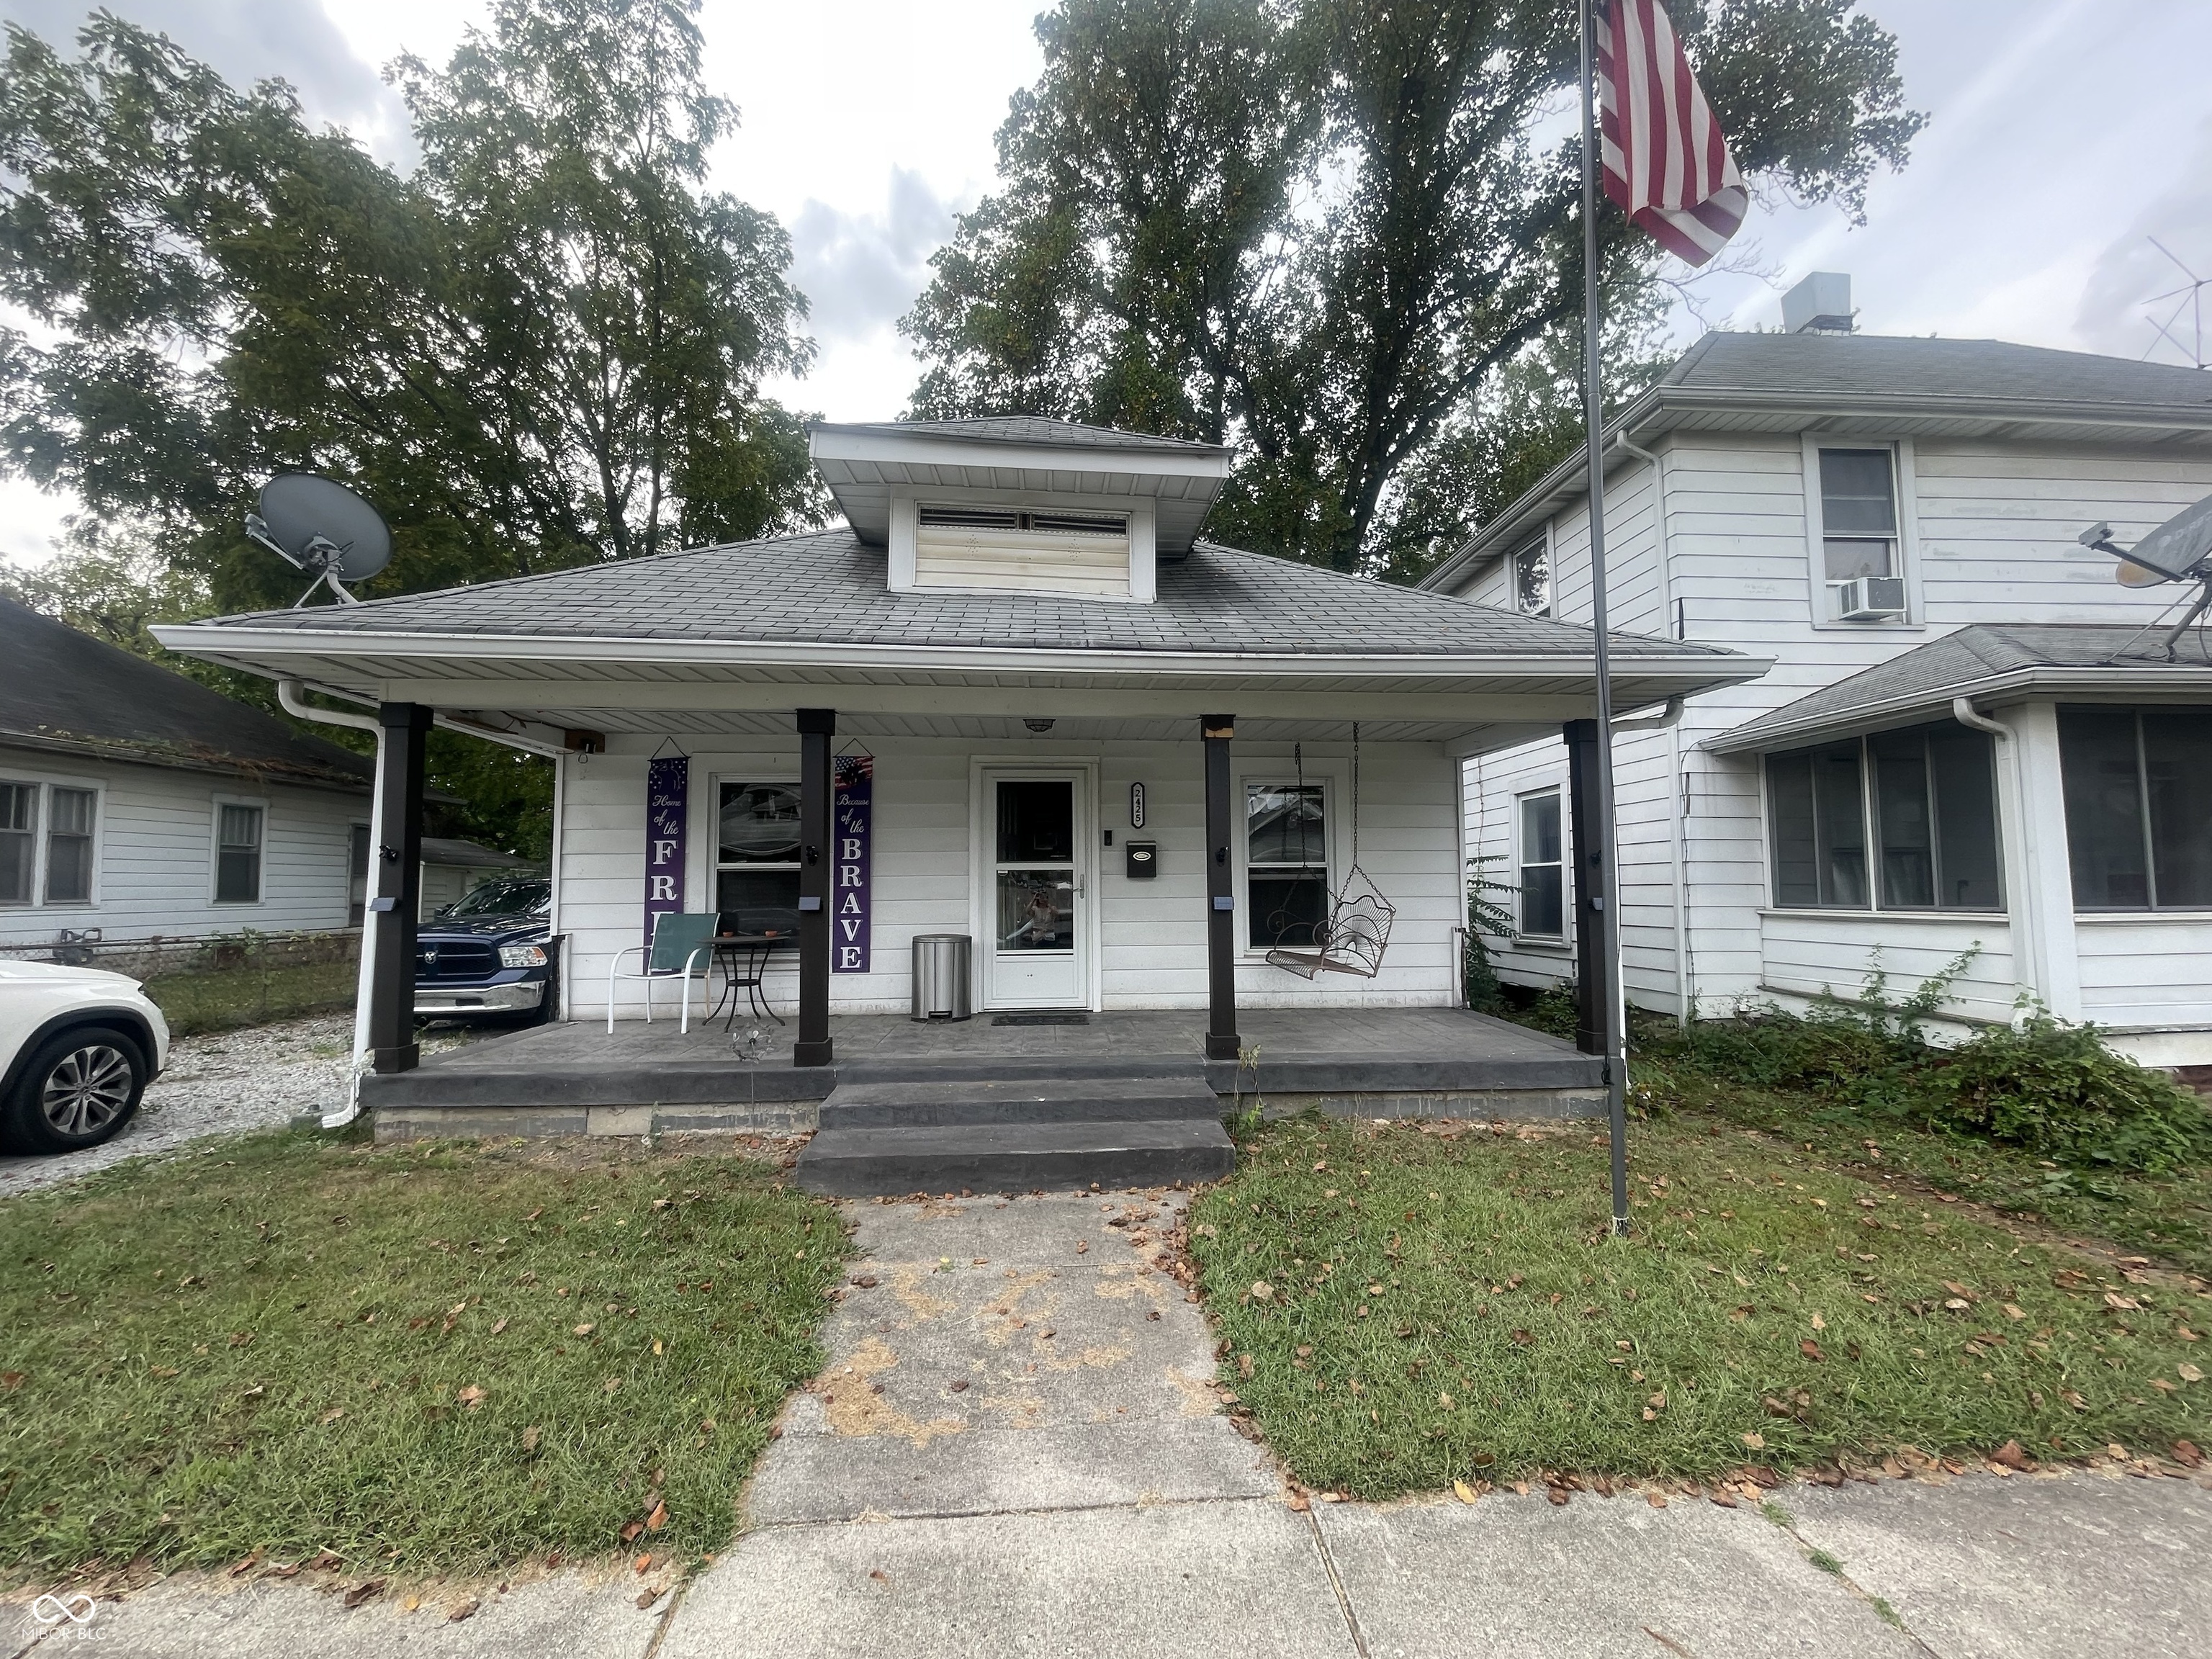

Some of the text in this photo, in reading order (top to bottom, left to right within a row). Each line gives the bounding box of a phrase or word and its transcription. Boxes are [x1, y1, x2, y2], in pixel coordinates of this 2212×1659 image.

[652, 794, 682, 806] Home
[836, 793, 870, 806] Because
[654, 809, 680, 835] of the
[840, 807, 865, 833] of the
[649, 840, 678, 972] FR
[840, 838, 863, 969] BRAVE
